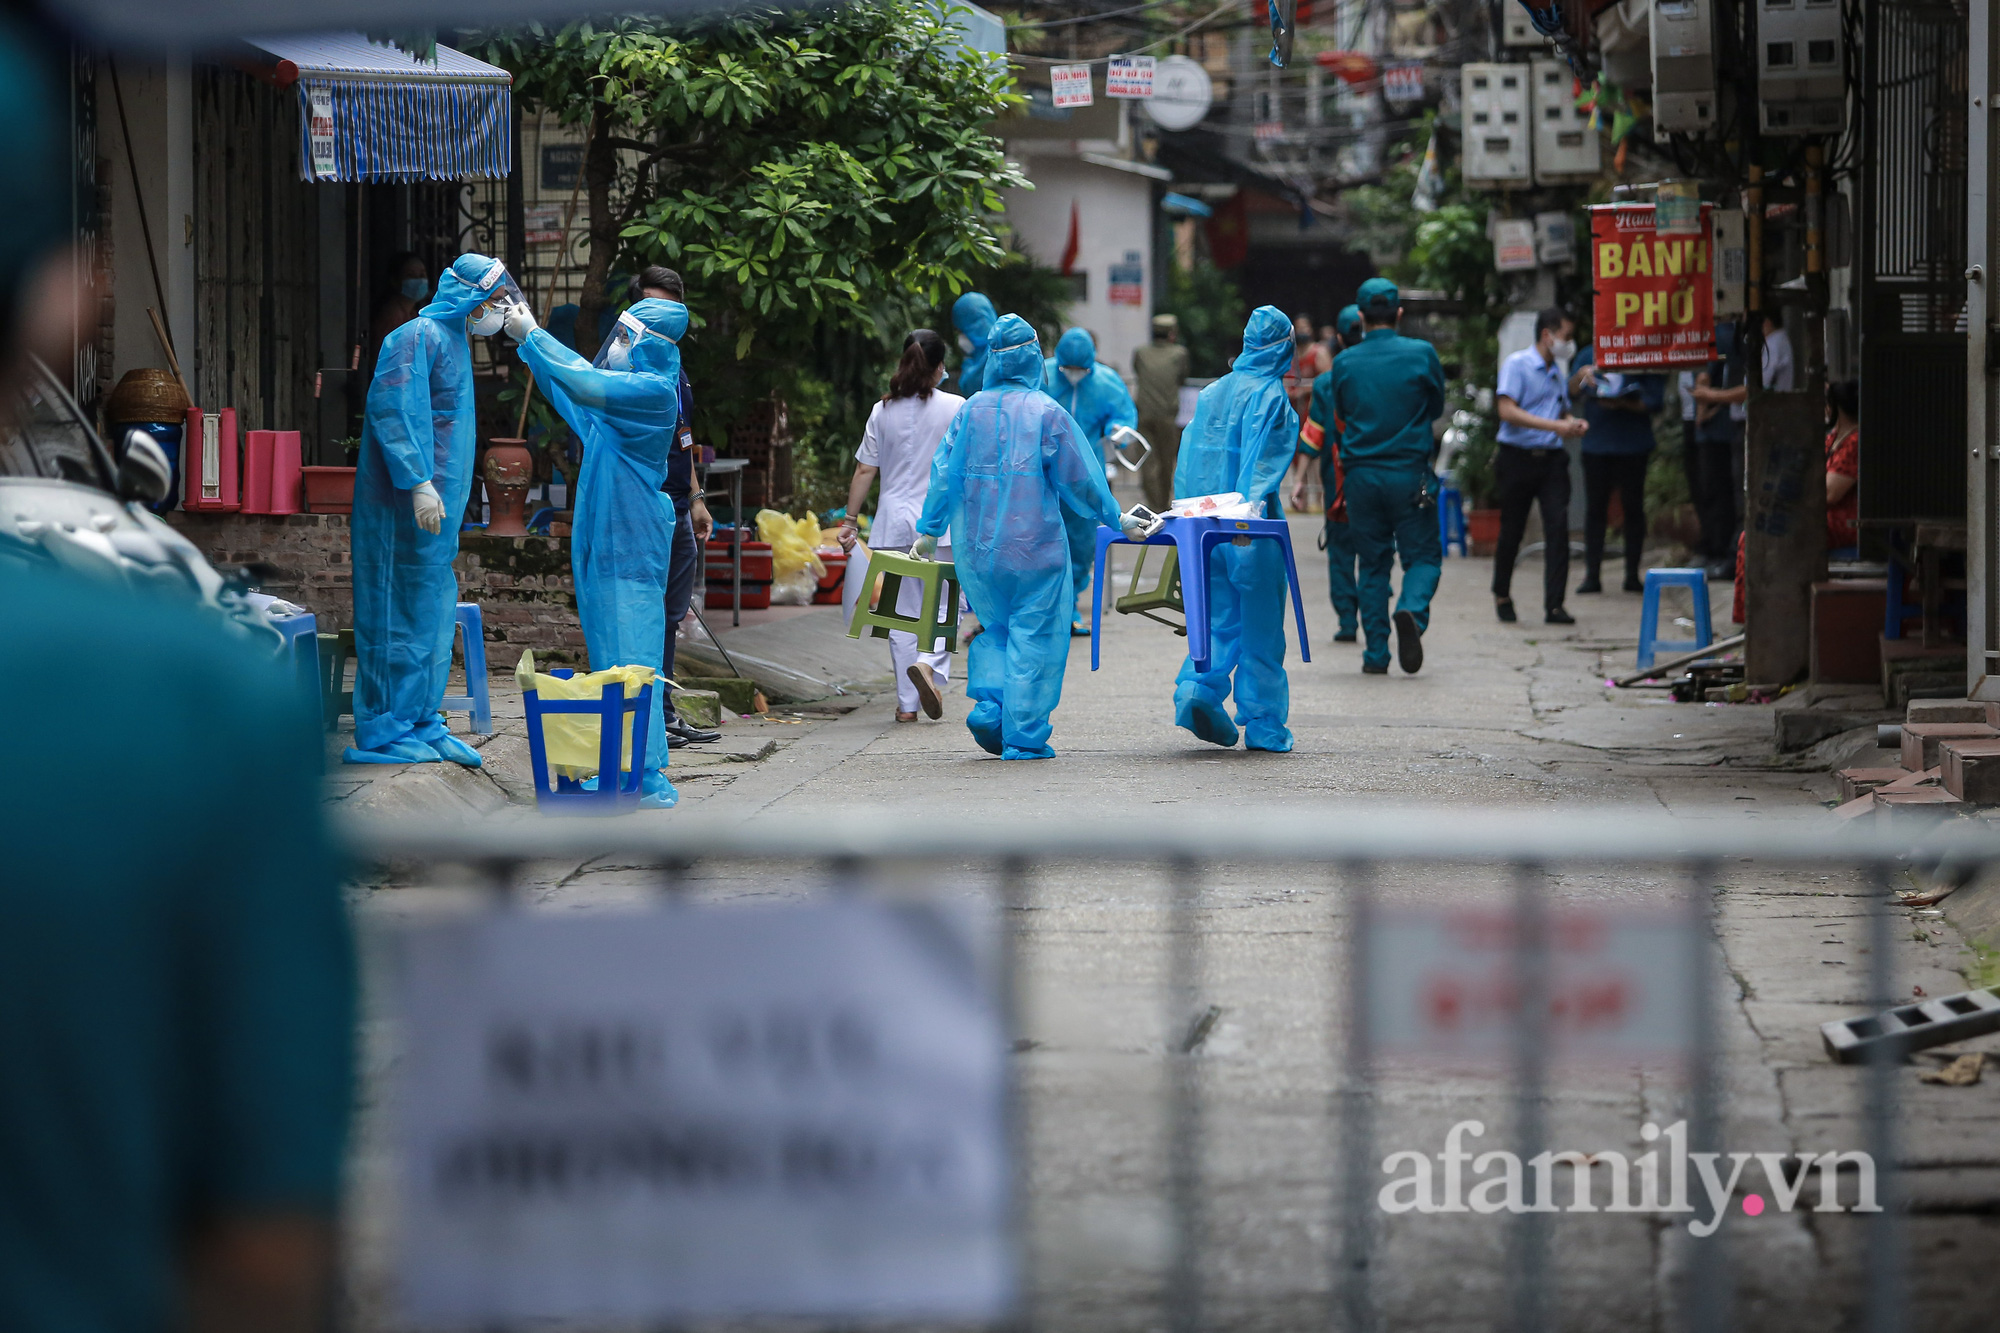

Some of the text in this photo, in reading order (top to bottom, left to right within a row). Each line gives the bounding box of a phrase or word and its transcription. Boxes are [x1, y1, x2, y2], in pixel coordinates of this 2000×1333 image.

[80, 211, 97, 289] TÓC
[1599, 234, 1708, 279] BÁNH
[1615, 278, 1696, 328] PHỞ
[79, 341, 98, 407] NAM
